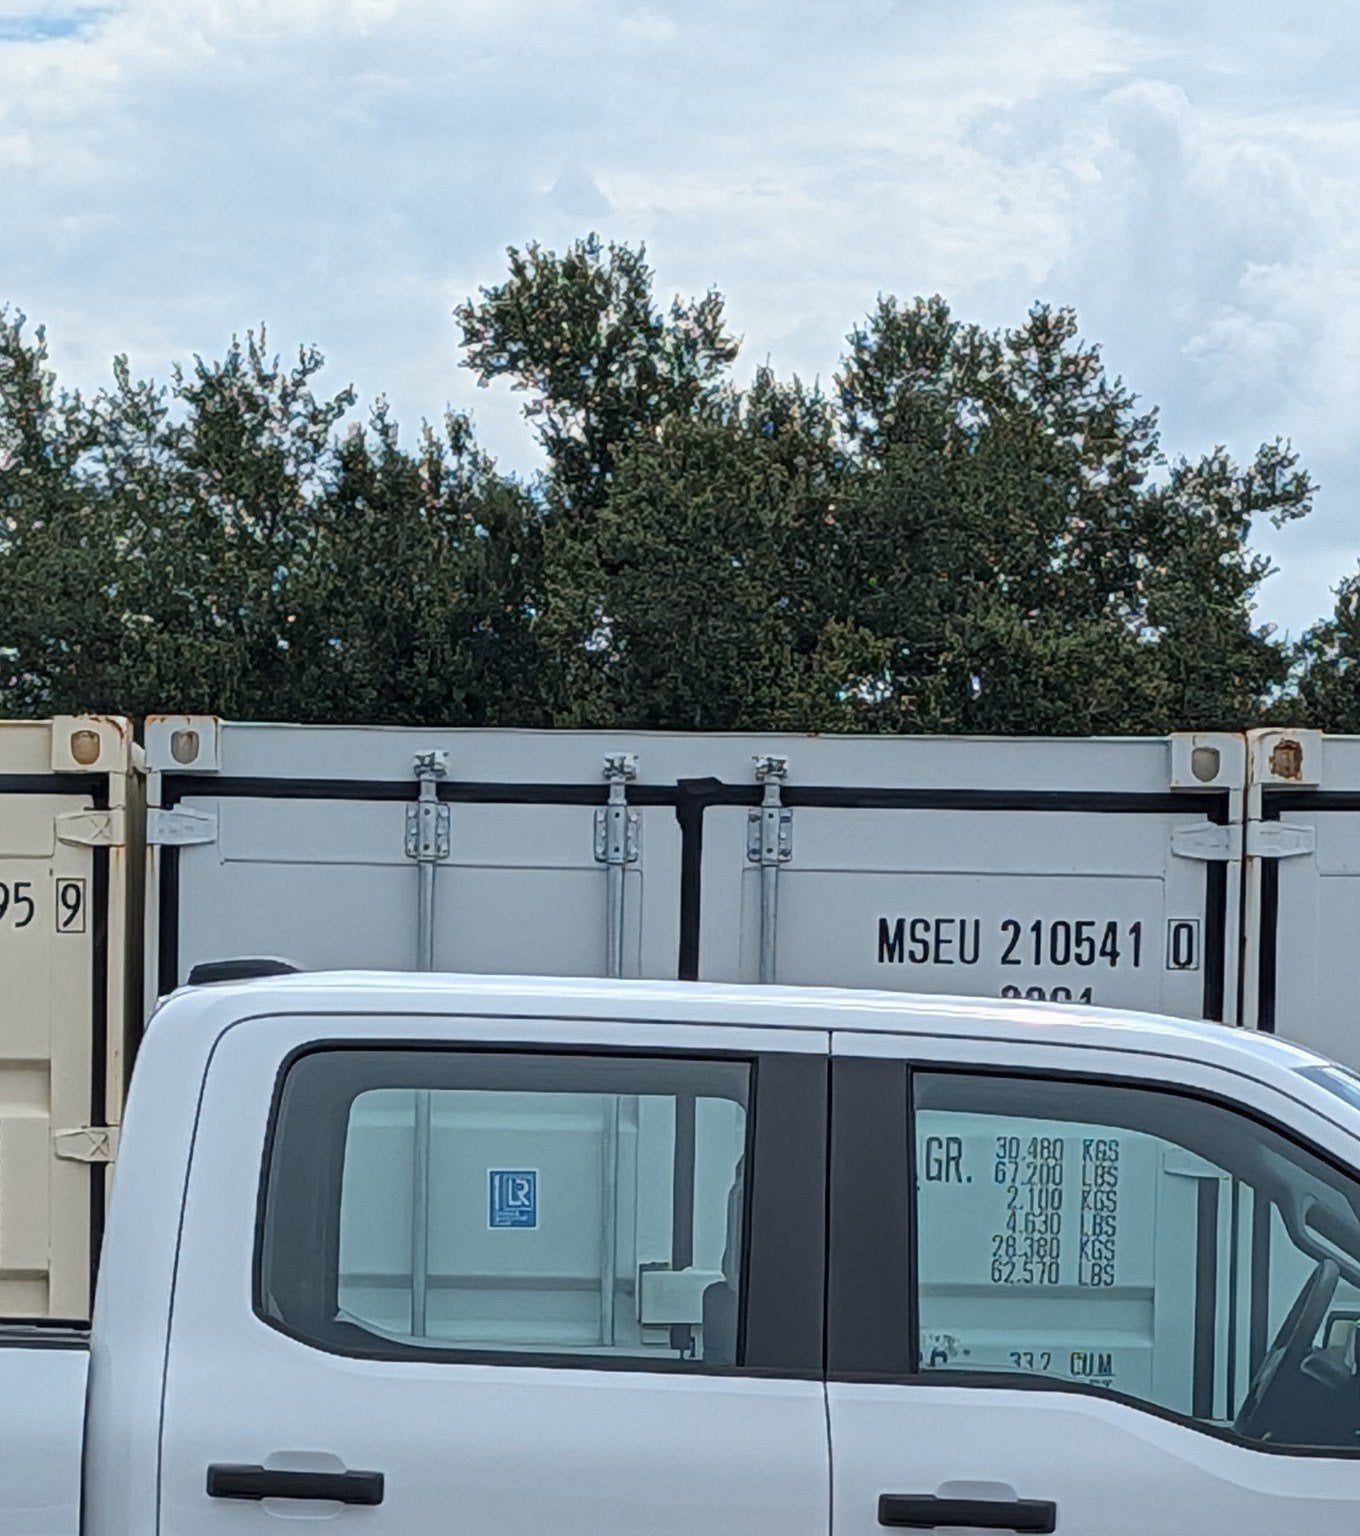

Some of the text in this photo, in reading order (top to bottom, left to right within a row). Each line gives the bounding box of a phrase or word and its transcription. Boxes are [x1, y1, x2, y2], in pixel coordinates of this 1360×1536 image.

[60, 882, 82, 928] 9
[877, 917, 1194, 968] MSEU 210541 0
[926, 1136, 973, 1184] GR.
[996, 1137, 1119, 1161] 30.480 KGS
[1082, 1162, 1119, 1186] LBS
[1081, 1186, 1117, 1212] KGS
[1080, 1212, 1116, 1236] LBS
[1080, 1236, 1116, 1260] KGS
[991, 1259, 1115, 1285] 62.570 LBS
